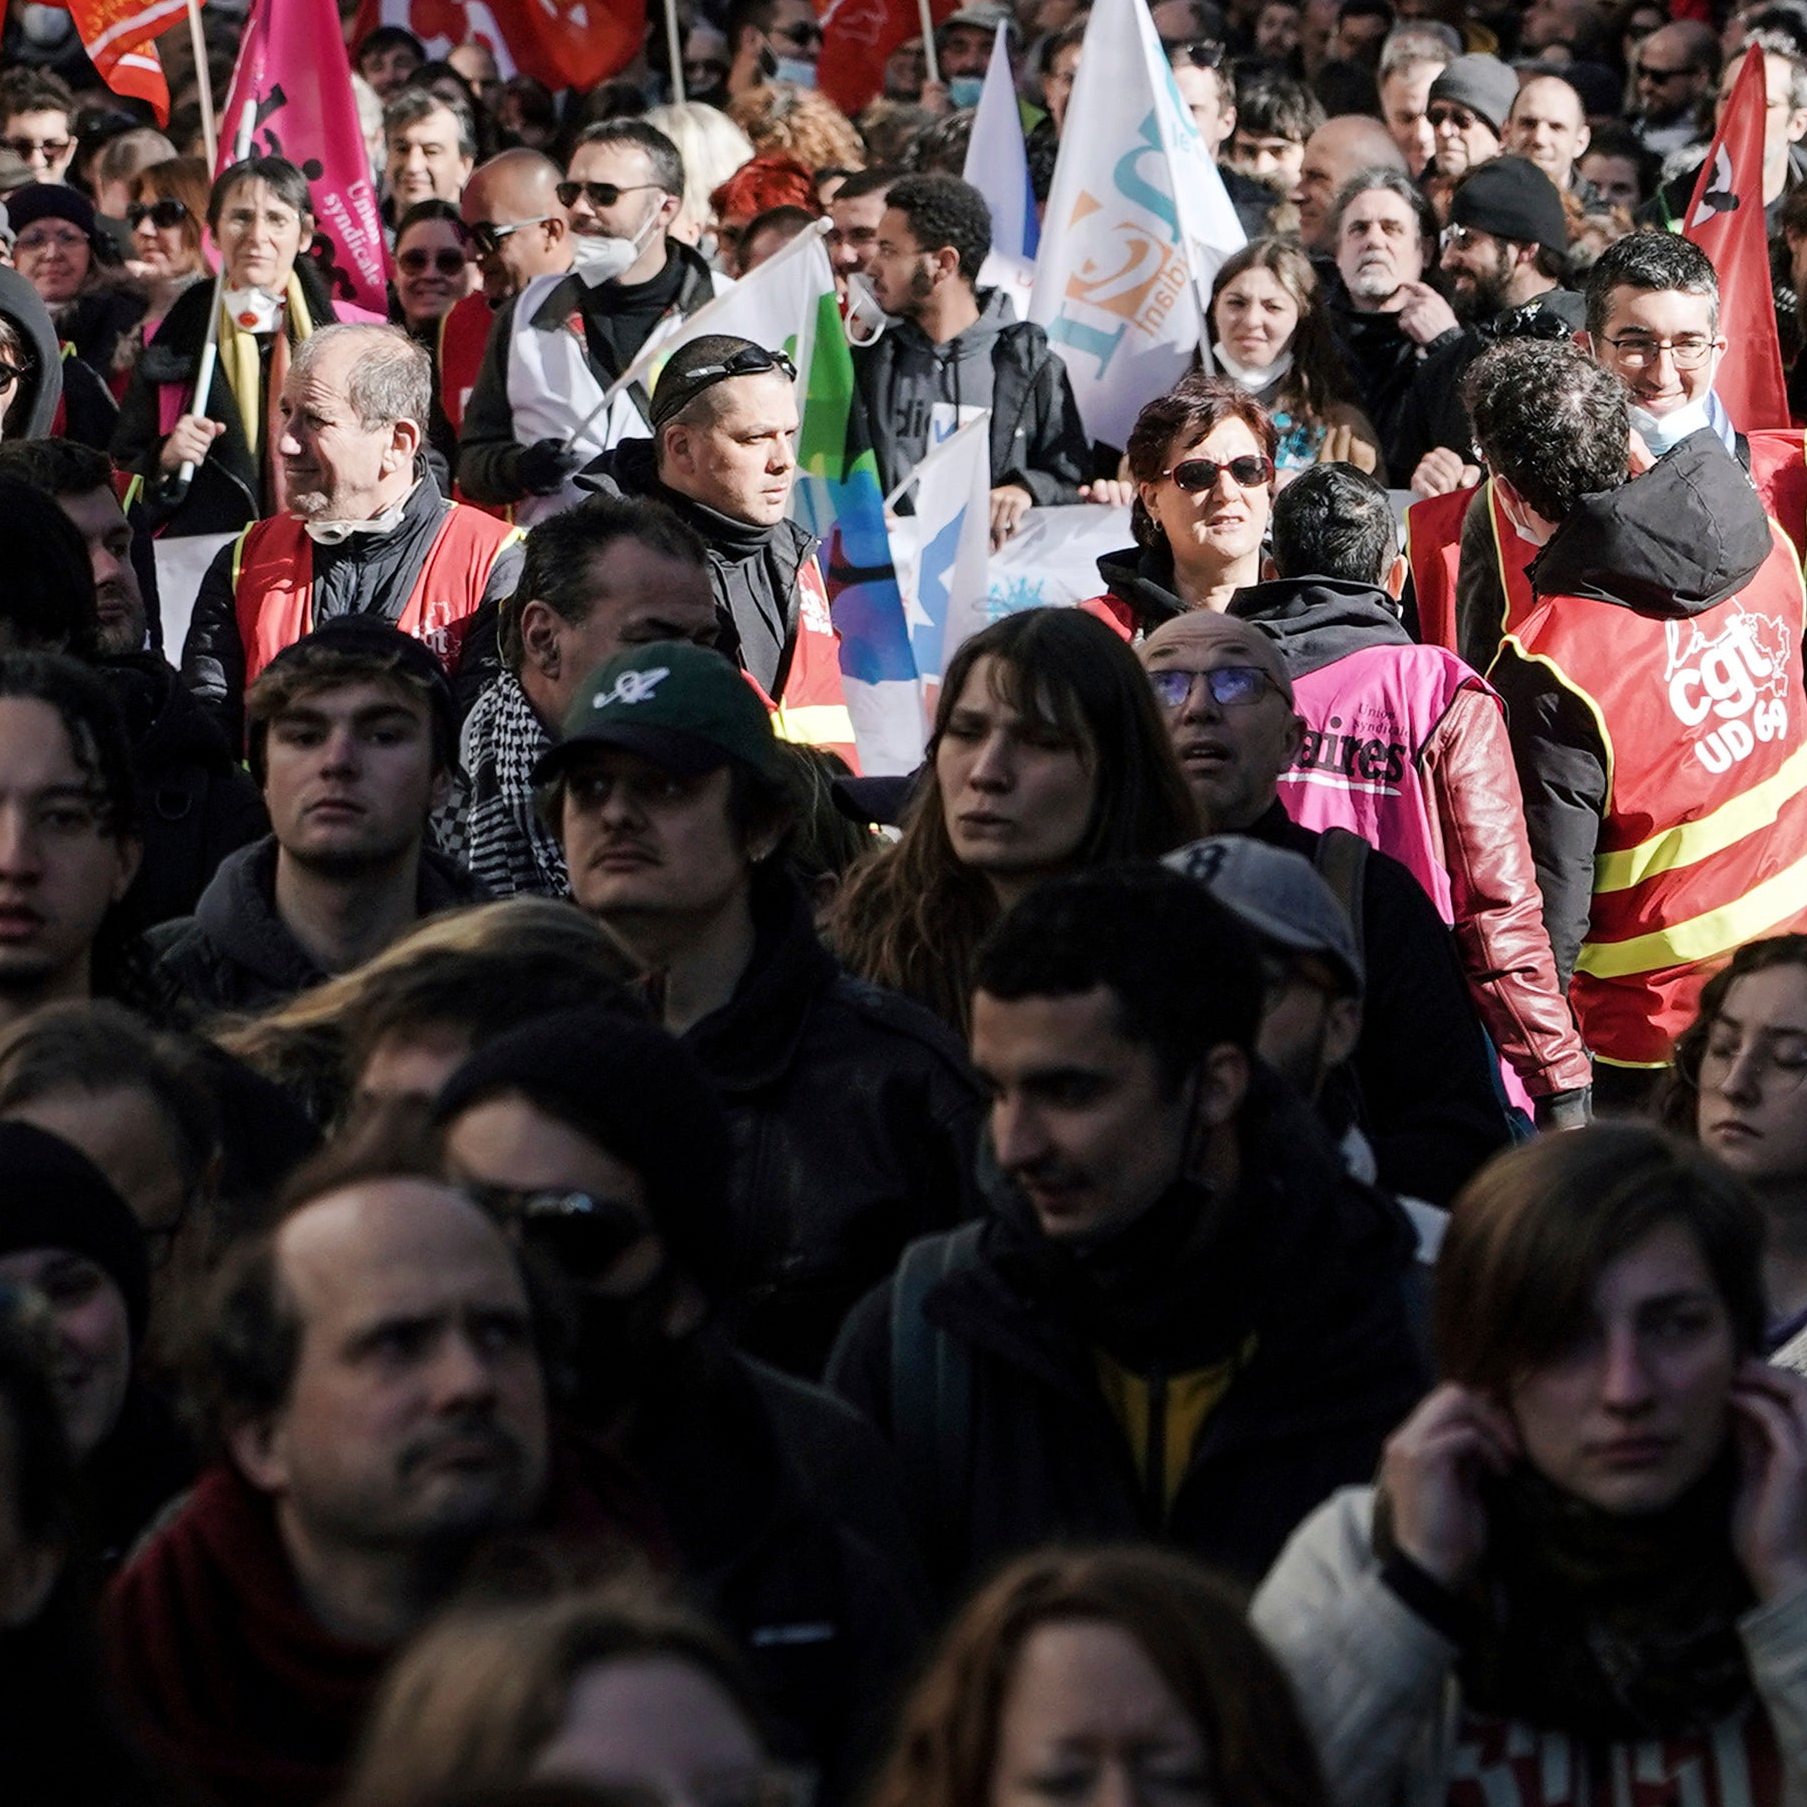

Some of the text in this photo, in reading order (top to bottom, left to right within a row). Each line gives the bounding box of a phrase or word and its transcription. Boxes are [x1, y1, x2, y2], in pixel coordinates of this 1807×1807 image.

[323, 192, 382, 287] syndicale
[1669, 613, 1773, 727] cgt
[1296, 715, 1407, 783] aires
[1358, 703, 1396, 721] Union
[1694, 698, 1789, 774] UD 69
